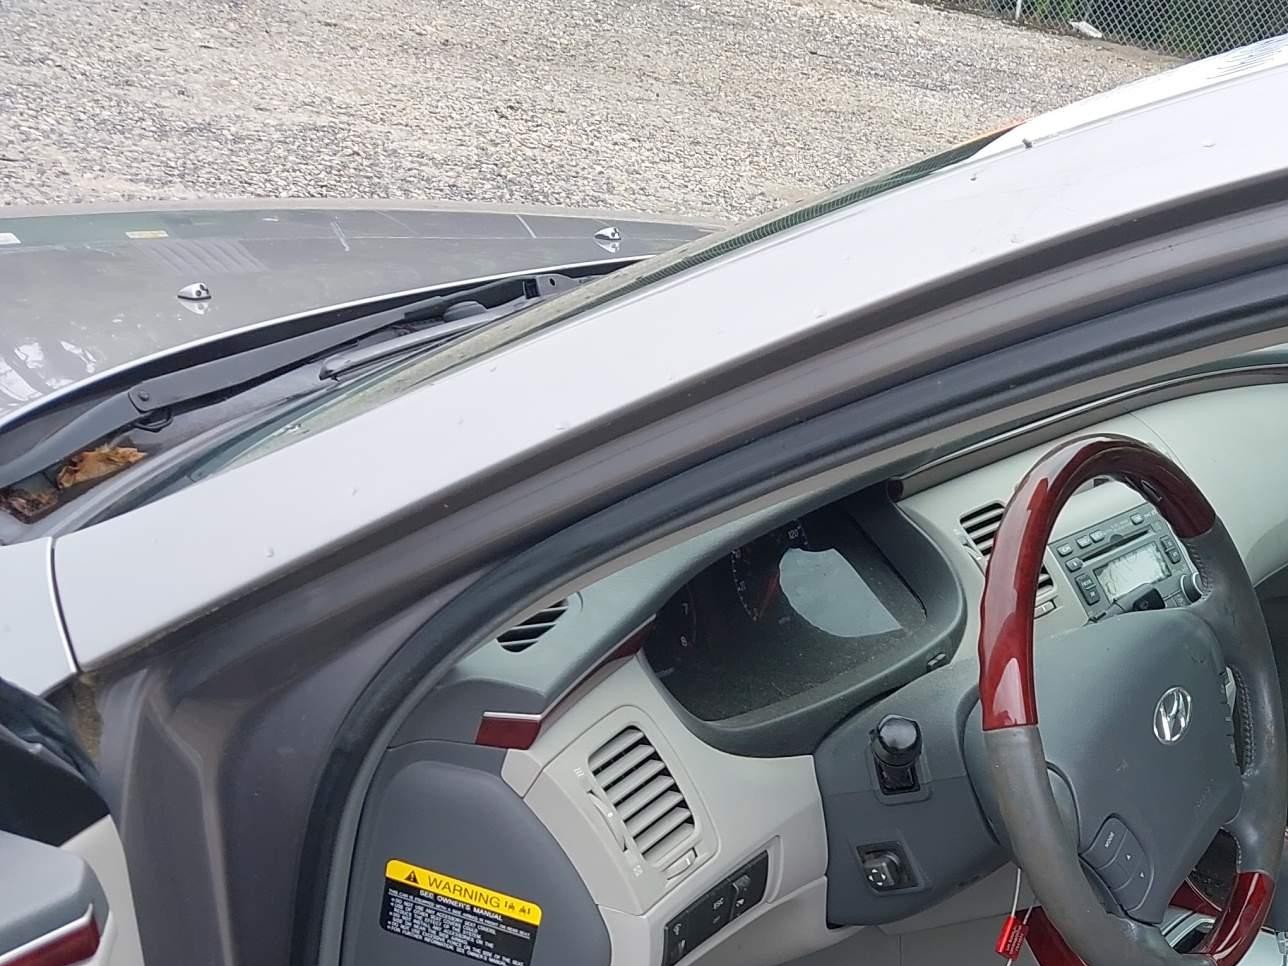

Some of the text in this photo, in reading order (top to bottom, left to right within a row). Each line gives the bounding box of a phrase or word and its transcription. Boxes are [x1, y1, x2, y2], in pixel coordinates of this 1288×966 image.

[420, 890, 434, 901] SEE
[437, 894, 472, 911] OWNER'S
[474, 906, 503, 922] MANUAL
[428, 874, 501, 908] WARNING
